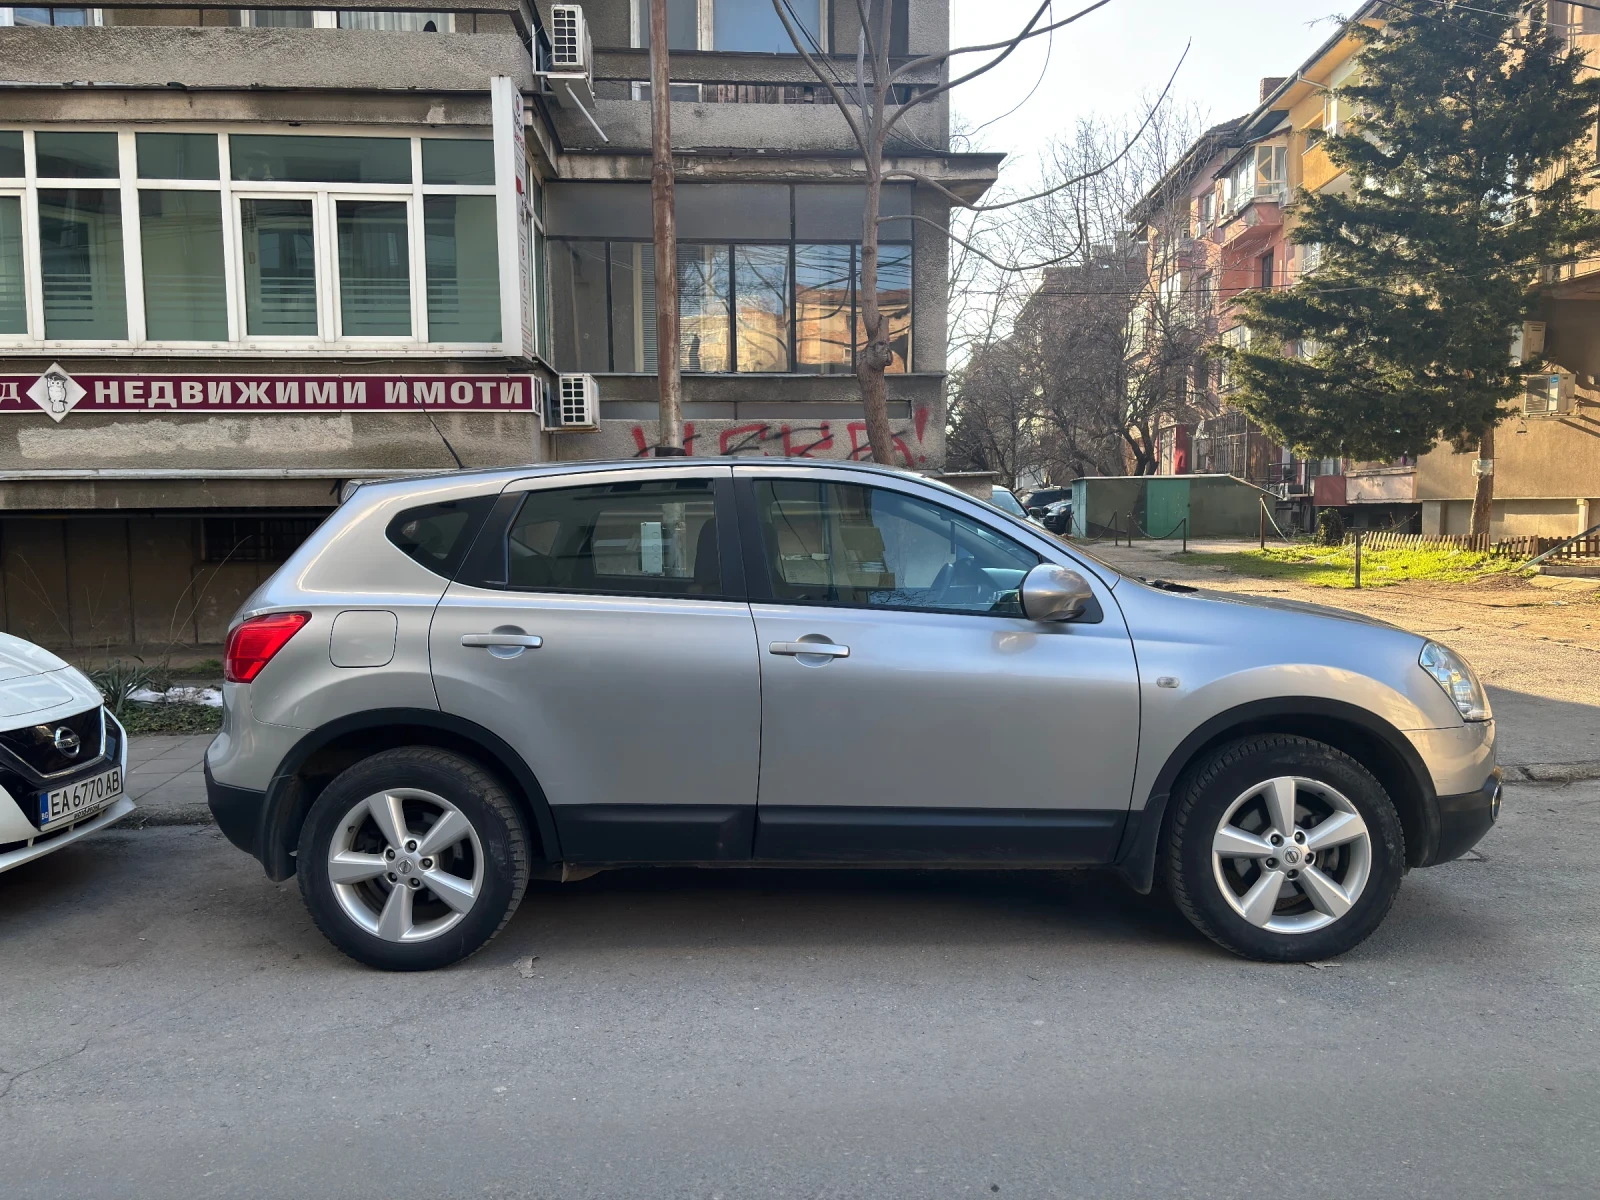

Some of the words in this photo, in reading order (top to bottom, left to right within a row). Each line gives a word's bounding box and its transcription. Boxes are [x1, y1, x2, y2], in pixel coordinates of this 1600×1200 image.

[94, 381, 367, 407] НЕДВИЖИМИ
[384, 381, 523, 404] ИМОТИ
[51, 790, 70, 817] EA
[73, 777, 103, 808] 6770
[106, 771, 120, 796] AB
[41, 811, 49, 820] BG
